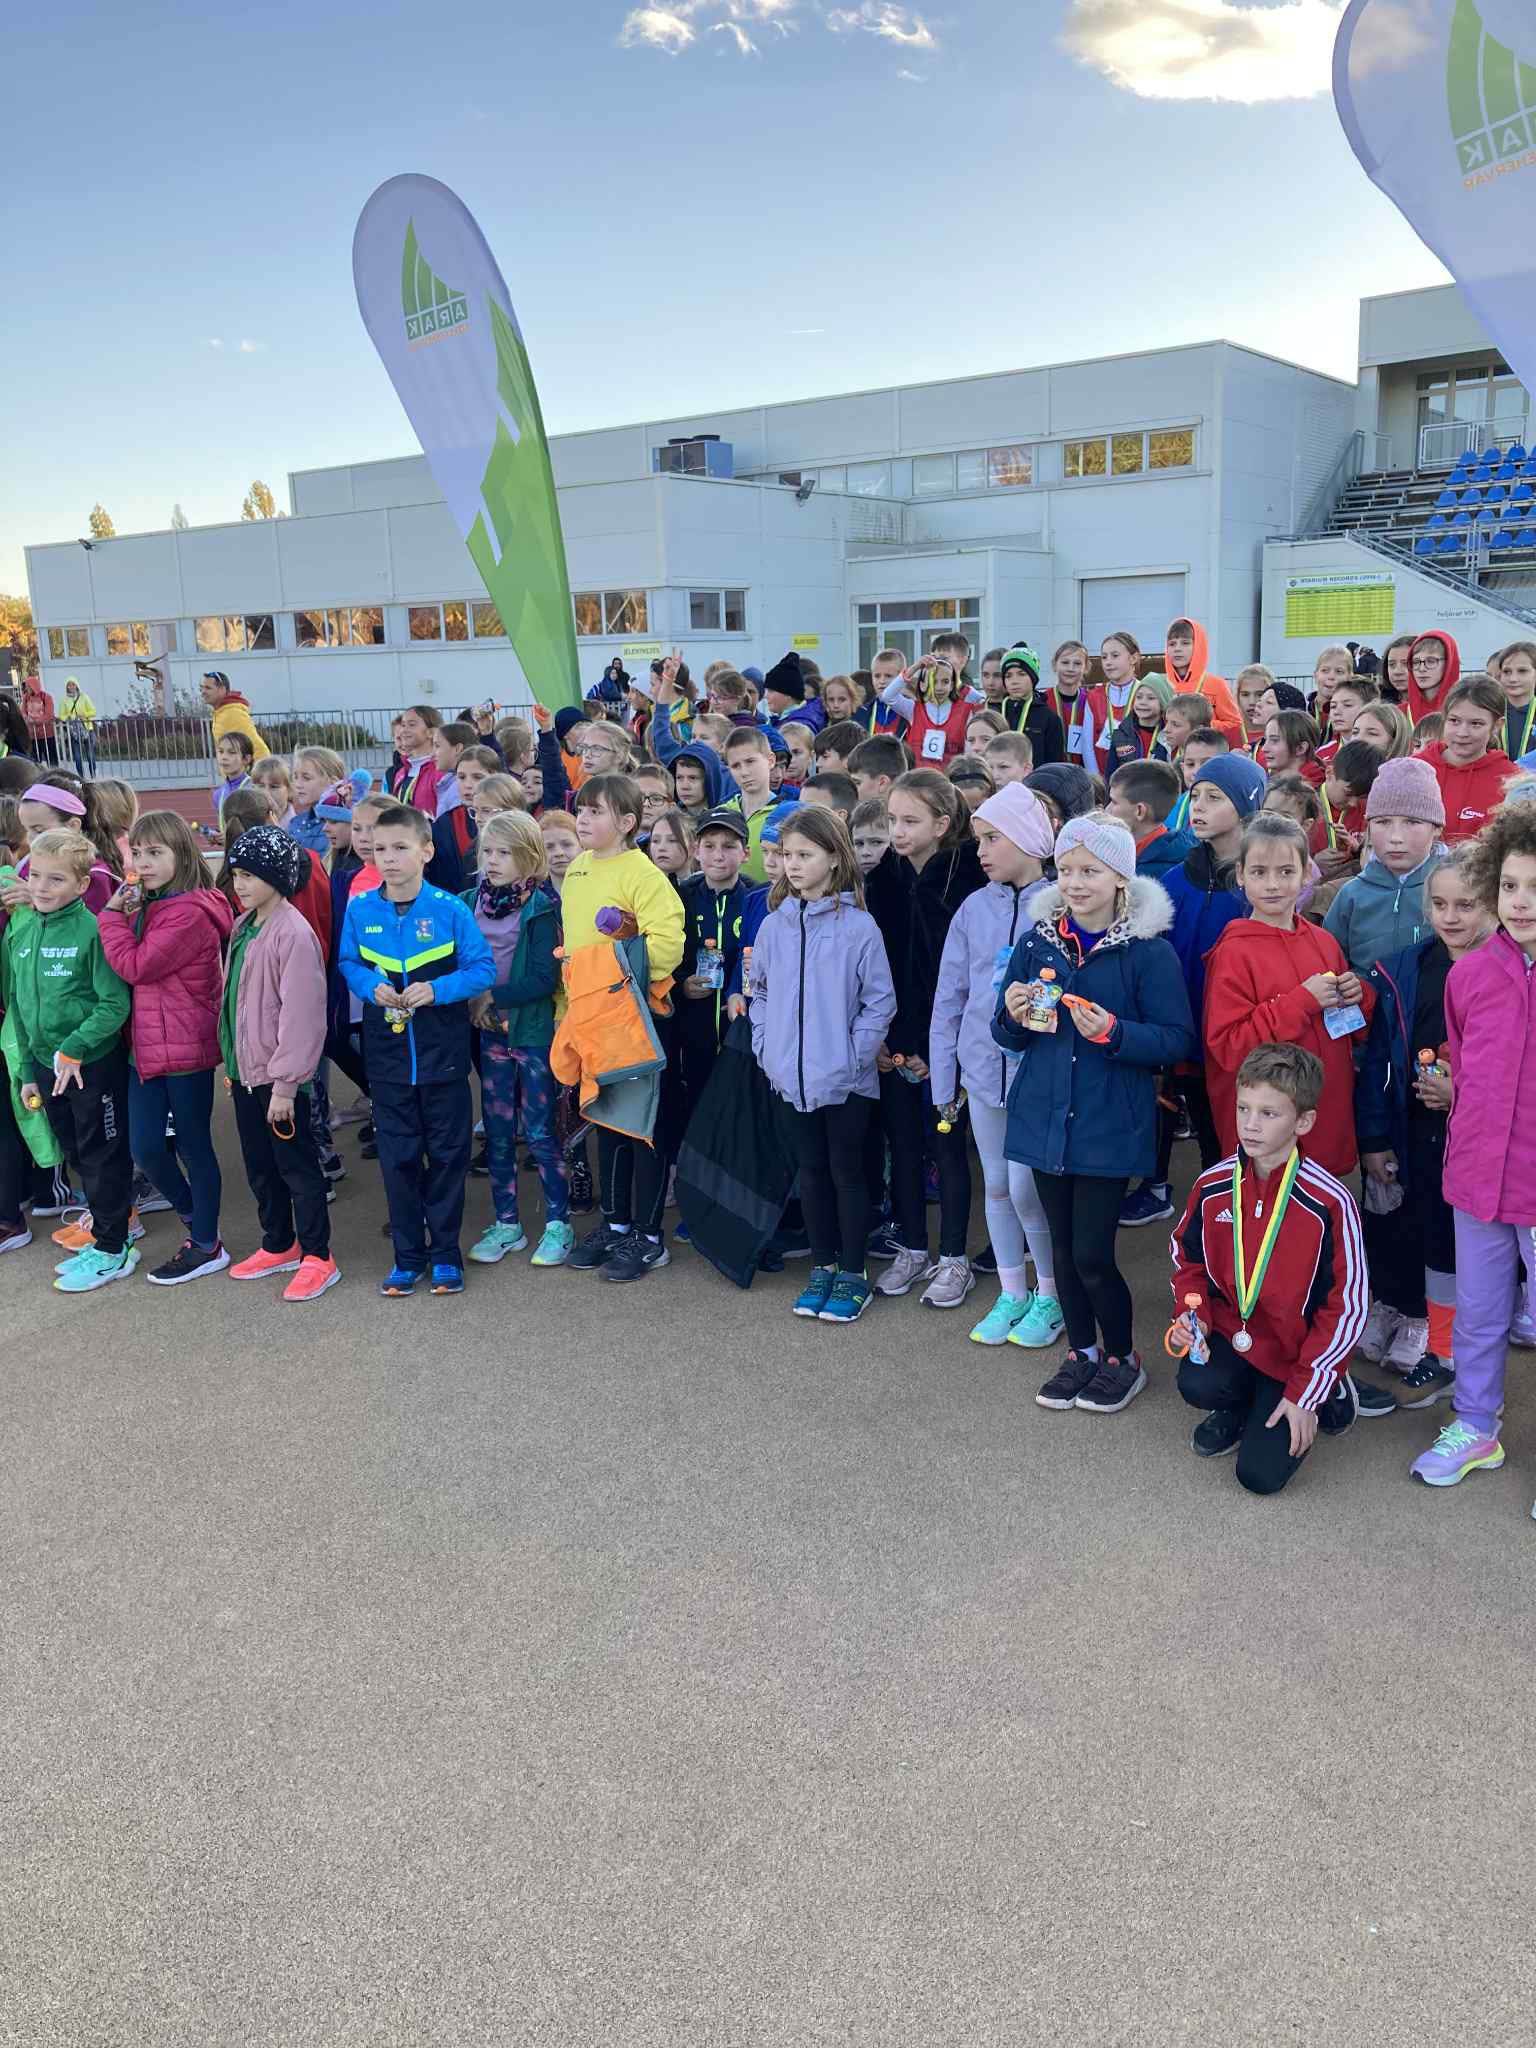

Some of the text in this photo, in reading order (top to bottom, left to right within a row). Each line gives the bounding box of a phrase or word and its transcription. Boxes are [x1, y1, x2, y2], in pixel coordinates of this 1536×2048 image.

[928, 736, 939, 753] 6
[1072, 732, 1081, 748] 7
[101, 1094, 117, 1141] Joma
